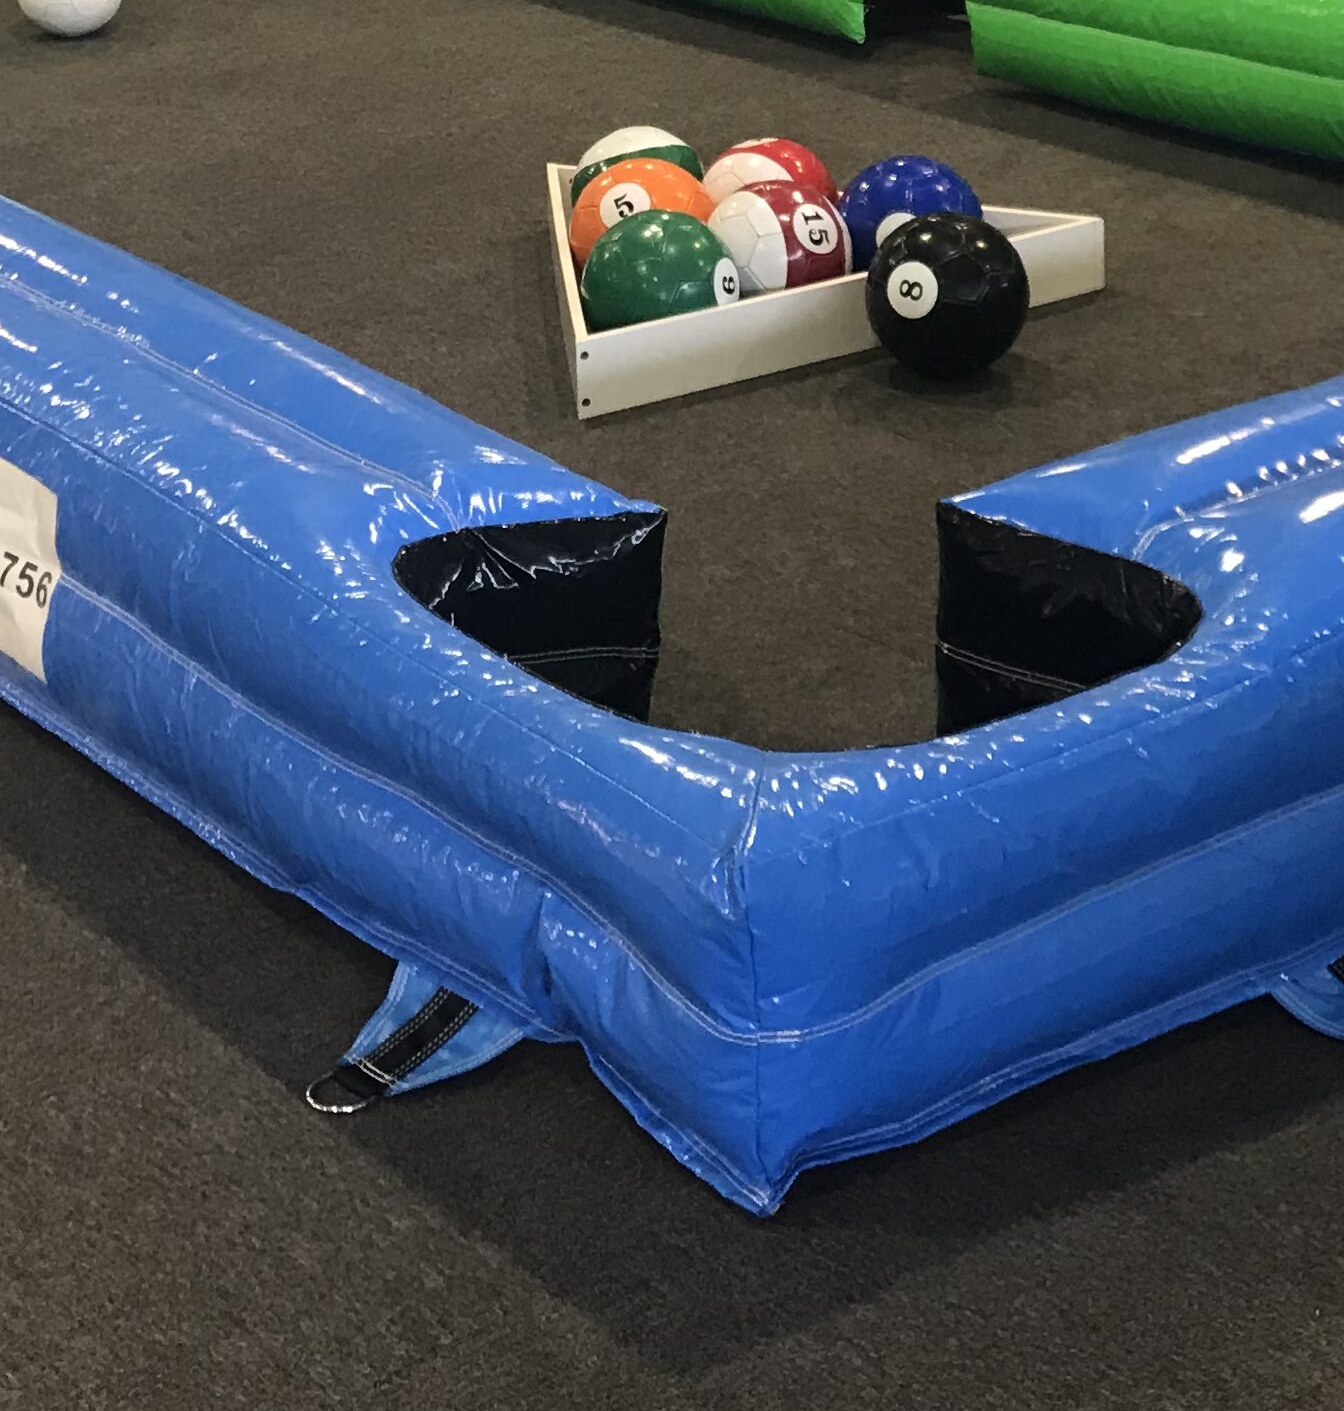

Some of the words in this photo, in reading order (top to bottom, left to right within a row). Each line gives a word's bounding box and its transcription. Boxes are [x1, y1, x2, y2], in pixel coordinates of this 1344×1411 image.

[613, 193, 634, 219] 5
[801, 211, 831, 247] 15
[899, 279, 923, 302] 8
